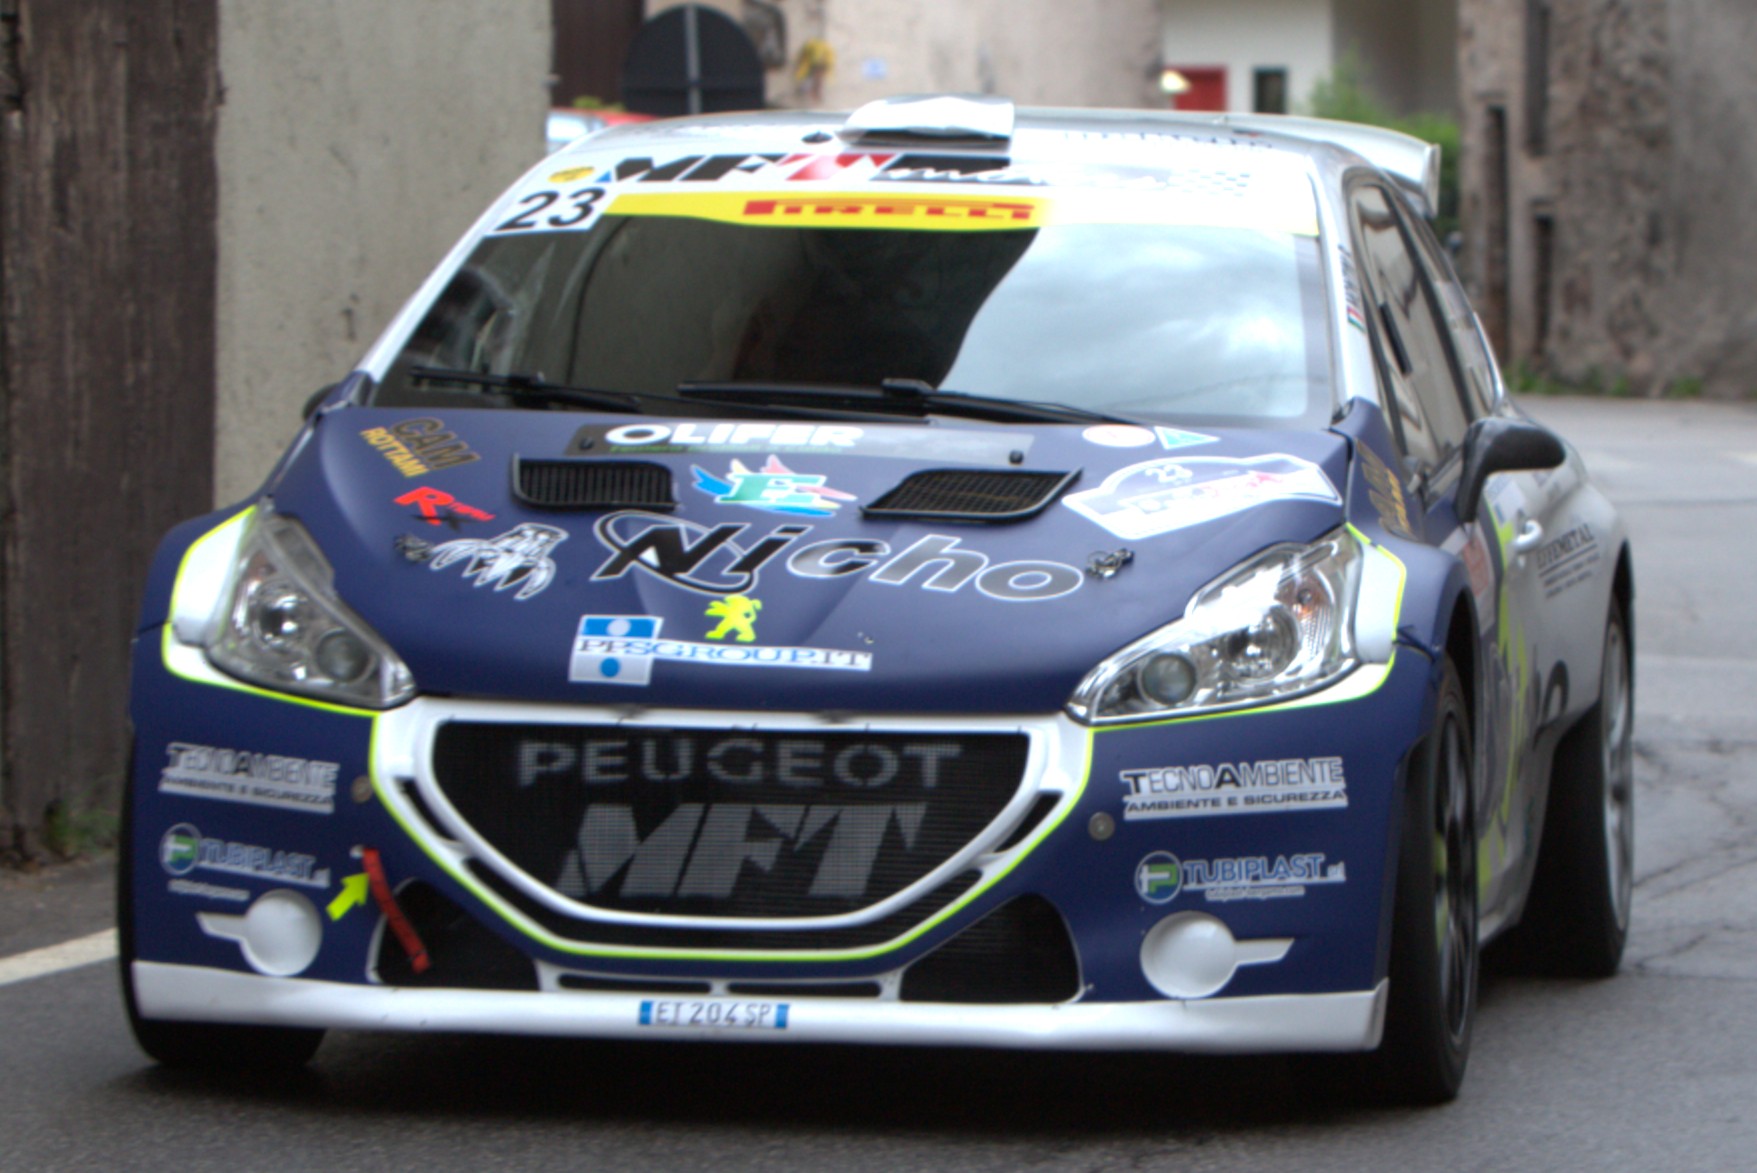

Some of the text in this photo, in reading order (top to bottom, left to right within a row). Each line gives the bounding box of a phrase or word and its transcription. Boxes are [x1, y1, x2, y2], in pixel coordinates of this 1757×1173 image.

[493, 187, 606, 232] 23
[743, 198, 1035, 221] PIRELLI
[605, 423, 864, 447] OLIFER
[590, 511, 1085, 600] Nicho
[516, 738, 963, 788] PEUGEOT
[1120, 758, 1345, 795] TECNOAMBIENTE
[1127, 788, 1346, 813] AMBIENTE E SICUREZZA
[555, 803, 927, 898] MFT
[1183, 855, 1324, 884] TUBIPLAST
